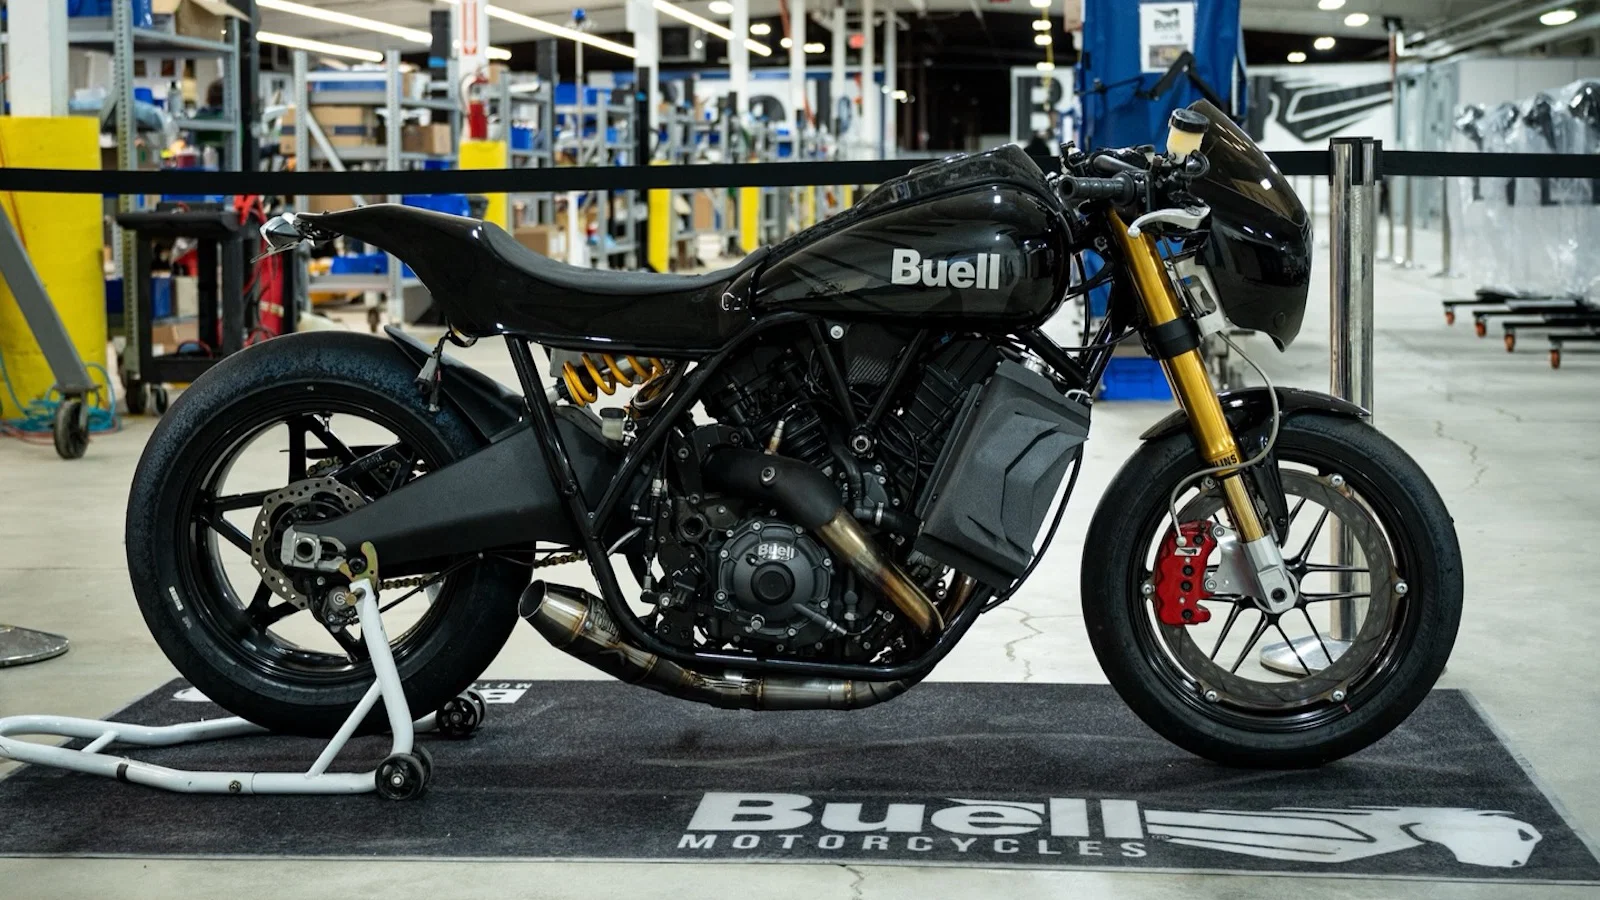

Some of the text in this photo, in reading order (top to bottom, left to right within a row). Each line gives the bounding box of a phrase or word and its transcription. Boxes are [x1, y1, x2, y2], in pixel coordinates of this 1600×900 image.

[891, 248, 1000, 290] Buell
[758, 543, 795, 559] Buell
[686, 792, 1144, 839] Buell
[677, 834, 1147, 858] MOTORCYCLES
